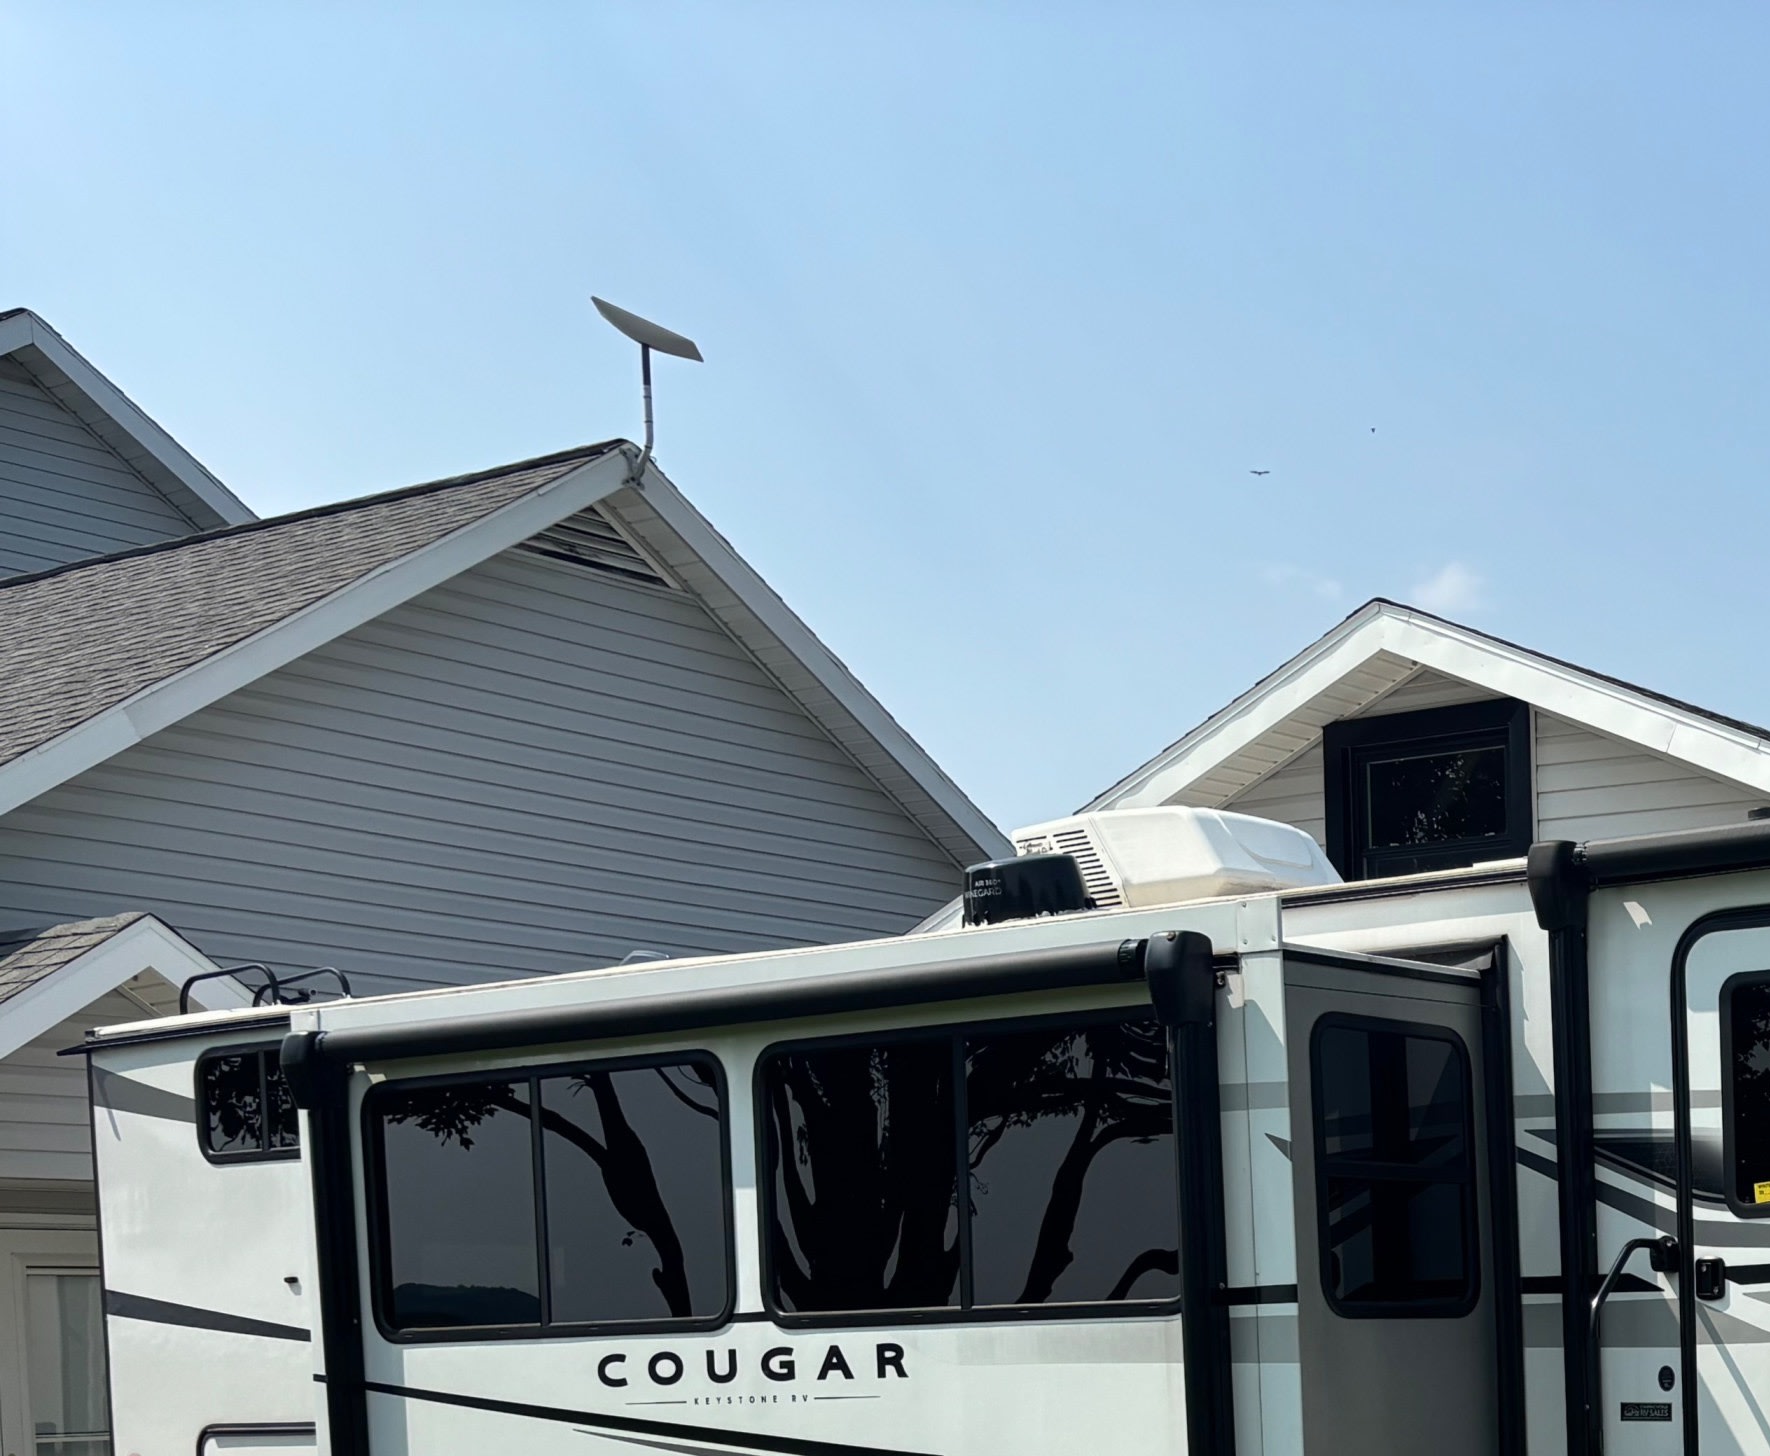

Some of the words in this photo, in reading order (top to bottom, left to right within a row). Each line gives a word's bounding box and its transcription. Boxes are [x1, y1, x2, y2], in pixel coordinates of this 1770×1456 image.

[597, 1342, 909, 1388] COUGAR
[694, 1395, 777, 1406] KEYSTONE
[792, 1394, 808, 1403] RV
